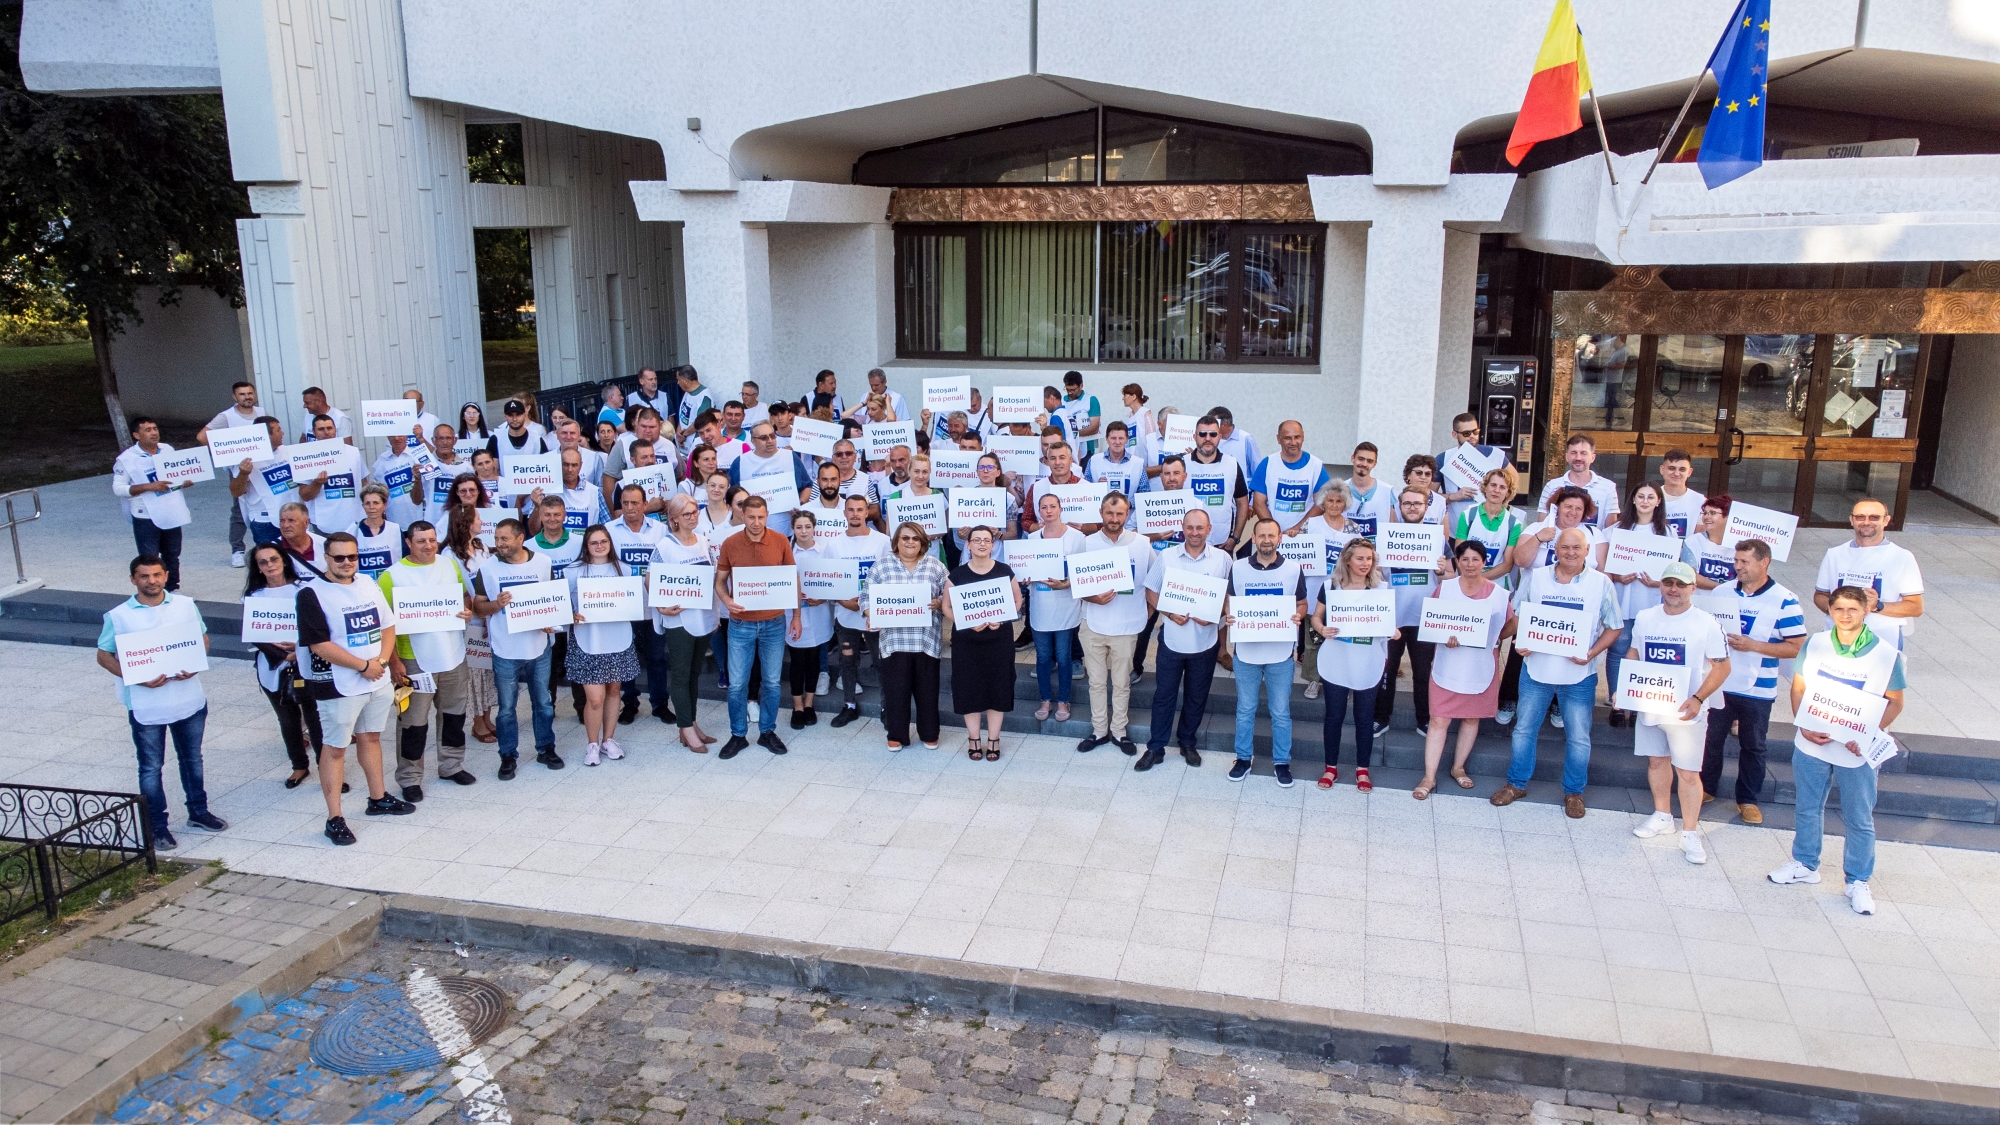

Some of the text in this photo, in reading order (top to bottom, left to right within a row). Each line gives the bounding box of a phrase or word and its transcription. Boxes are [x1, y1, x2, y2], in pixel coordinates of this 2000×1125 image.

[796, 429, 818, 437] Respect
[214, 436, 252, 447] Drumurile
[873, 436, 908, 446] Botoșani
[216, 445, 260, 456] banii noștri.
[293, 450, 329, 462] Drumurile
[164, 456, 201, 469] Parcări,
[294, 462, 313, 470] banii
[314, 459, 337, 468] noștri.
[936, 461, 969, 470] Botoșani
[1452, 460, 1468, 475] banii
[166, 471, 180, 479] nu
[181, 466, 205, 477] crini.
[513, 464, 551, 474] Parcări,
[514, 475, 554, 485] nu crini.
[772, 486, 792, 494] pentru
[897, 504, 921, 512] Vrem
[958, 498, 995, 507] Parcări,
[1144, 499, 1169, 507] Vrem
[898, 513, 937, 523] Botoșani
[974, 509, 997, 518] crini.
[1145, 507, 1186, 518] Botoșani
[1733, 516, 1775, 533] Drumurile
[1388, 530, 1415, 540] Vrem
[1730, 527, 1751, 538] banii
[1387, 542, 1432, 552] Botoșani
[1614, 544, 1674, 560] Respect pentru
[1386, 553, 1429, 562] modern.
[1613, 553, 1634, 562] tineri.
[1075, 561, 1114, 574] Botoșani
[660, 574, 702, 585] Parcări,
[1077, 571, 1126, 585] fără penali.
[676, 588, 703, 597] crini.
[960, 586, 1001, 600] Vrem un
[1167, 581, 1184, 592] Fără
[1185, 584, 1208, 596] mafie
[510, 596, 551, 609] Drumurile
[876, 596, 915, 605] Botoșani
[963, 596, 1004, 610] Botoșani
[1165, 592, 1196, 604] cimitire.
[399, 601, 443, 609] Drumurile
[583, 601, 616, 609] cimitire.
[1331, 604, 1374, 612] Drumurile
[252, 611, 295, 620] Botoșan
[423, 610, 451, 618] noștri.
[511, 606, 559, 618] banii noștri.
[896, 607, 925, 616] penali.
[965, 608, 1005, 621] modern.
[1237, 609, 1278, 619] Botoșani
[1426, 611, 1470, 622] Drumurile
[1354, 615, 1382, 624] noștri.
[1530, 616, 1577, 633] Parcări,
[251, 621, 272, 630] fără
[1237, 621, 1290, 630] fără penali.
[1424, 621, 1475, 634] banii noștri.
[1528, 631, 1578, 646] nu crini.
[126, 640, 197, 658] Respect pentru
[128, 658, 155, 668] tineri.
[1847, 671, 1868, 679] UNITĂ
[1629, 673, 1675, 689] Parcări,
[1627, 688, 1676, 703] nu crini.
[1812, 692, 1862, 717] Botoșani
[1807, 705, 1867, 734] fără penali.
